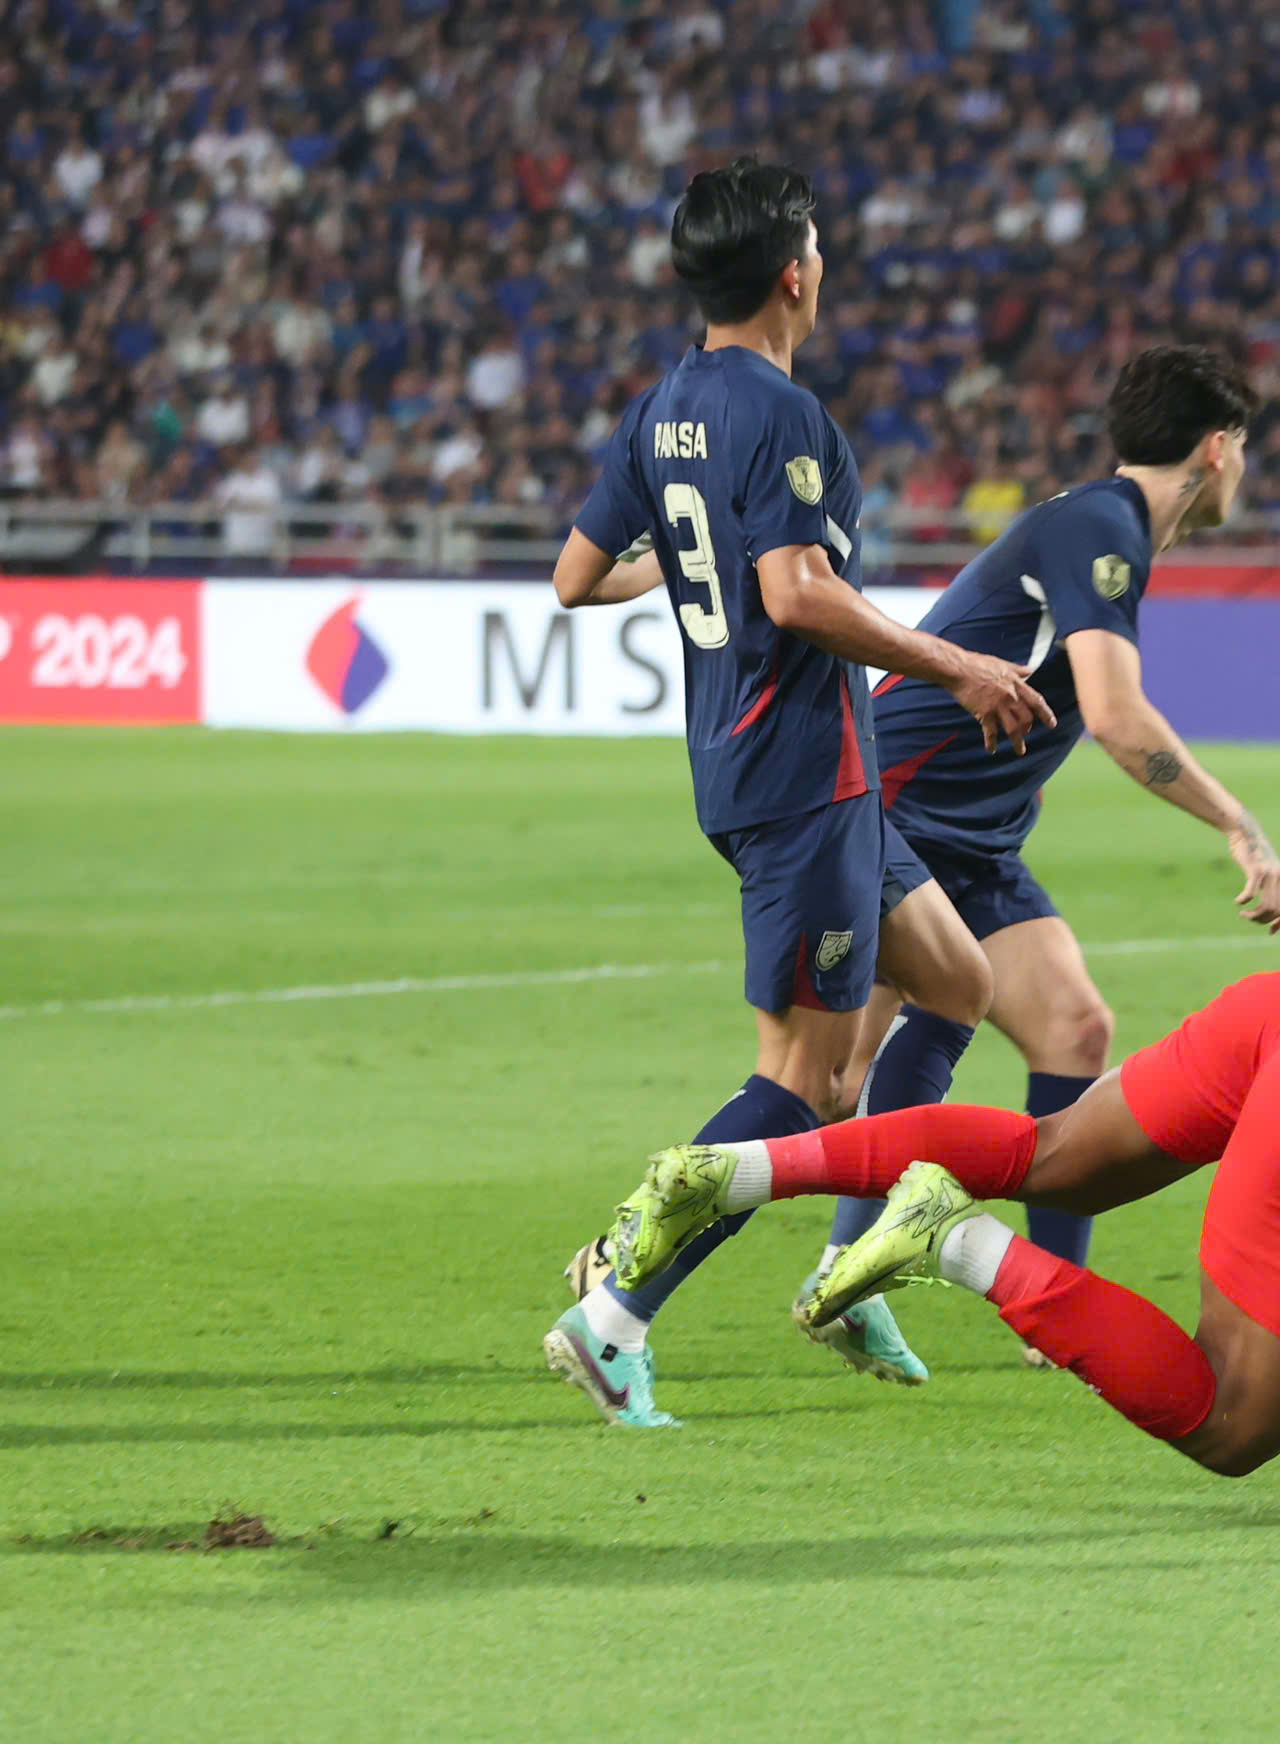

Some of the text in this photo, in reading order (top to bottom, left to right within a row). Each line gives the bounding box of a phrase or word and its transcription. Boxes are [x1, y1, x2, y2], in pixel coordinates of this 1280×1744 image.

[654, 421, 707, 459] PANSA
[664, 482, 729, 650] 3
[30, 614, 188, 688] 2024
